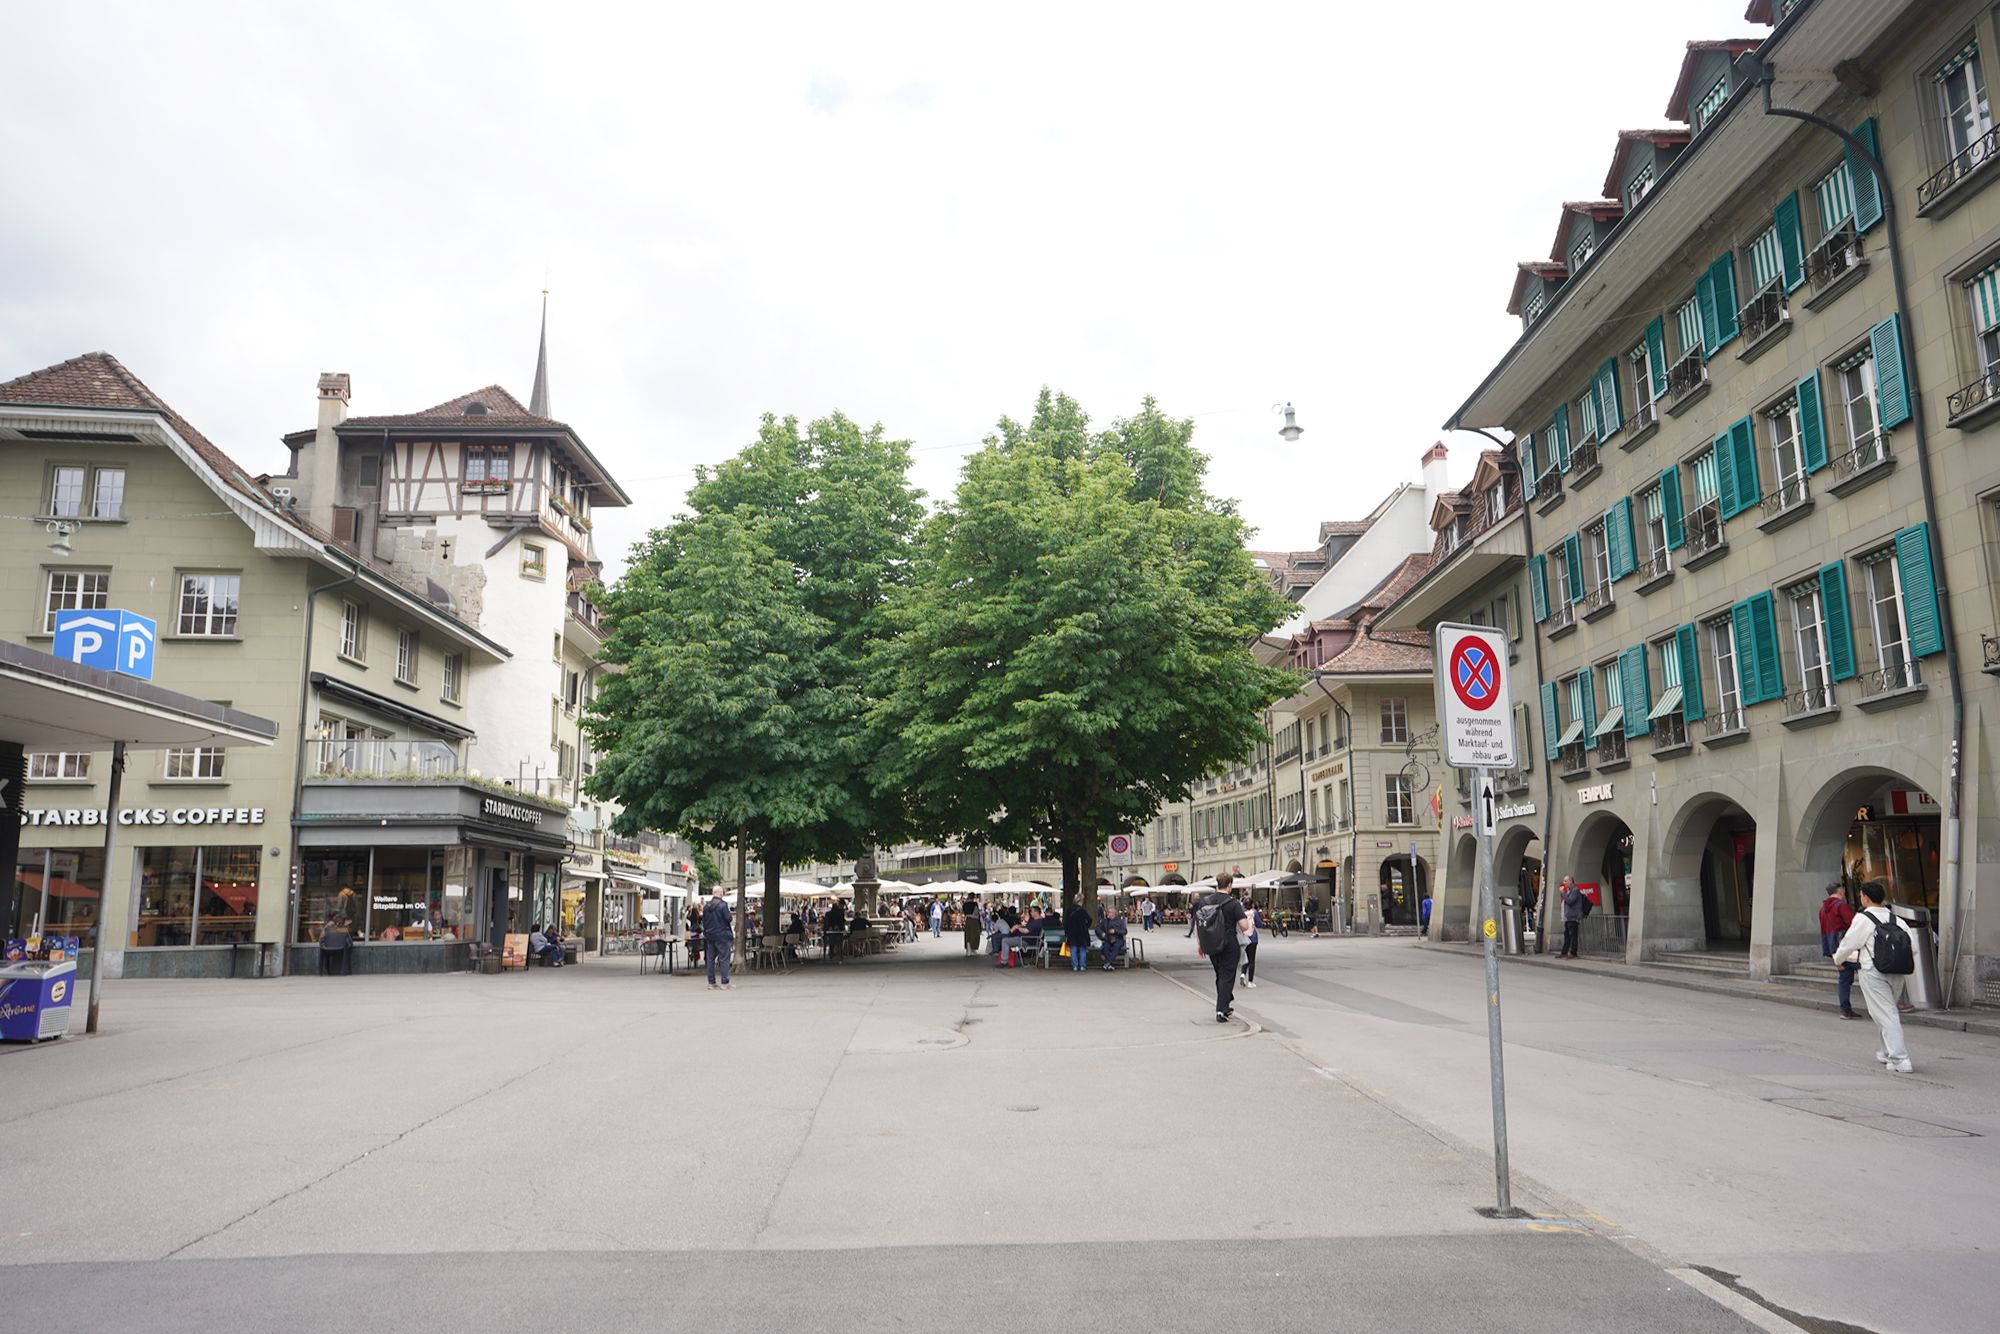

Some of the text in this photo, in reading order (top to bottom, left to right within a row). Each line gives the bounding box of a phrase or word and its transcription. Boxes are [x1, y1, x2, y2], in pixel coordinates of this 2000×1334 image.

[73, 631, 103, 664] P
[128, 635, 146, 669] P
[1456, 717, 1502, 727] ausgenommen
[1465, 727, 1493, 737] während
[1458, 738, 1503, 749] Marktauf- und
[1472, 750, 1492, 760] abbau
[1577, 782, 1613, 805] TEMPUR
[171, 808, 264, 826] COFFEE
[484, 798, 542, 825] STARBUCKS COFFEE
[373, 895, 398, 903] Weitere
